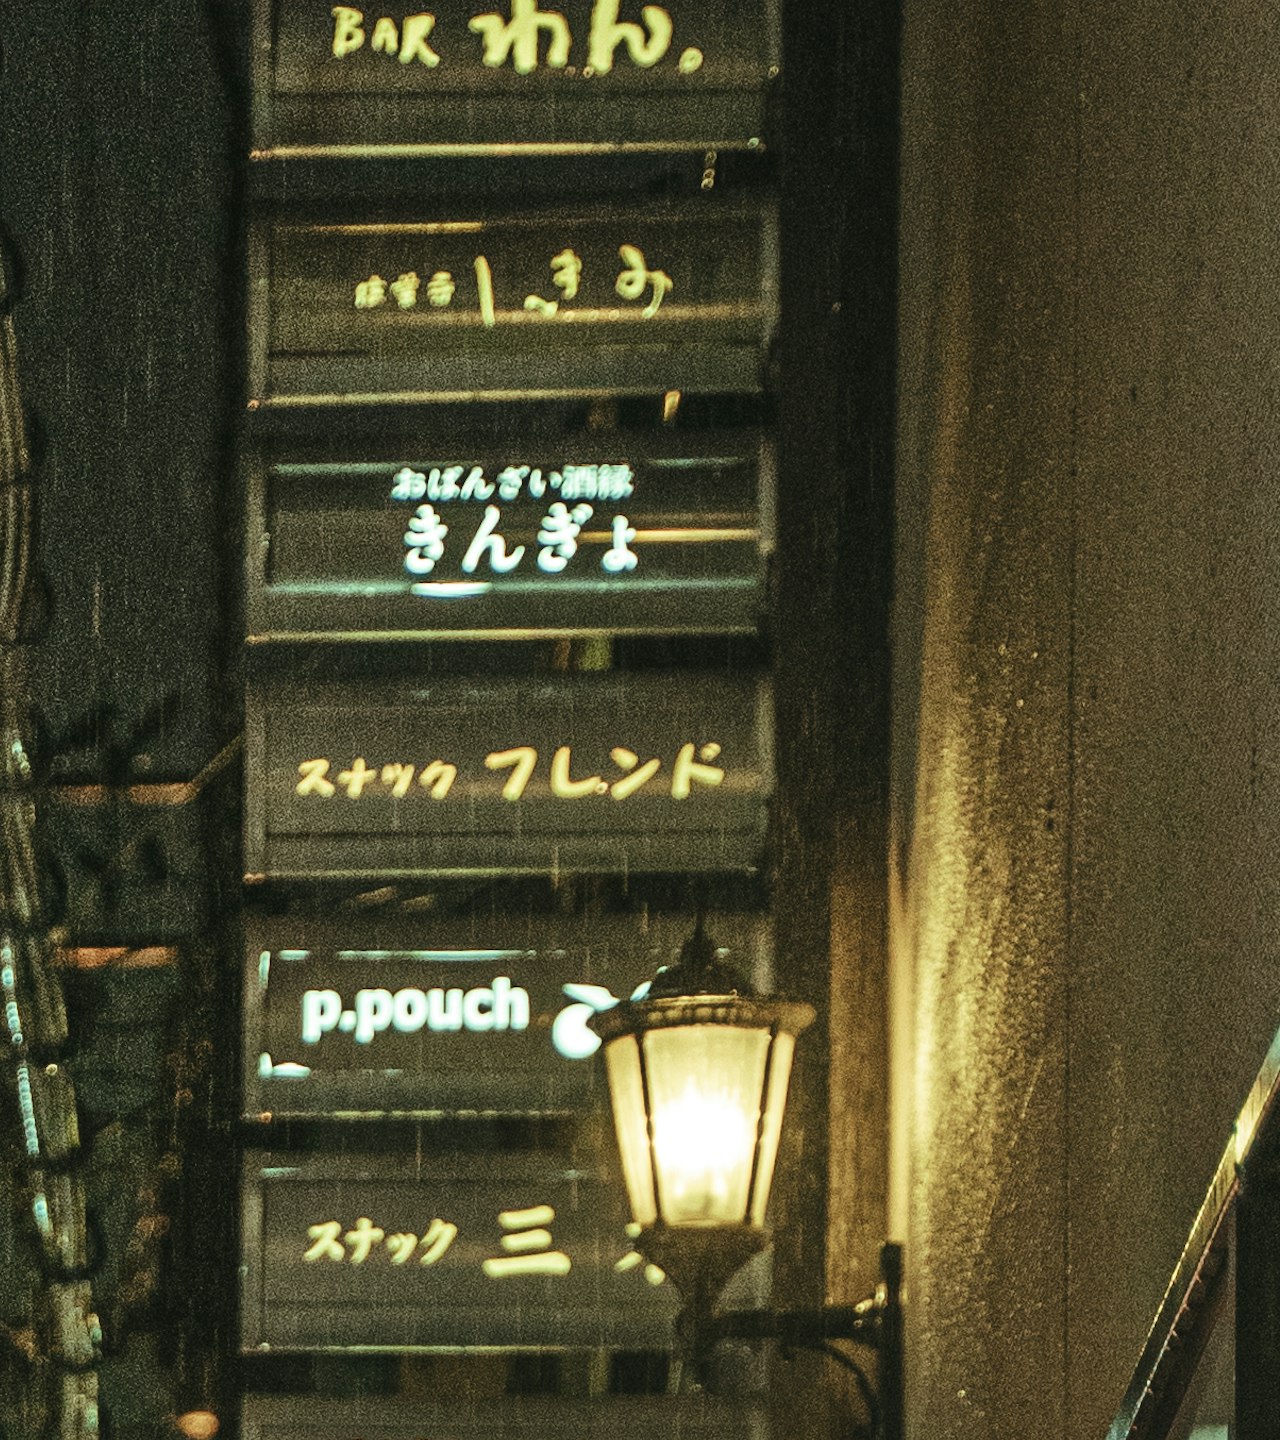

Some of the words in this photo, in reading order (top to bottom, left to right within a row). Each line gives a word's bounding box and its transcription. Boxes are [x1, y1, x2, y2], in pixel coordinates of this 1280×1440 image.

[331, 5, 441, 69] BAR
[403, 502, 639, 575] きんぎょ
[296, 757, 457, 798] スナック
[484, 741, 725, 800] フレンド
[301, 976, 531, 1043] p.pouch
[303, 1216, 459, 1266] スナック
